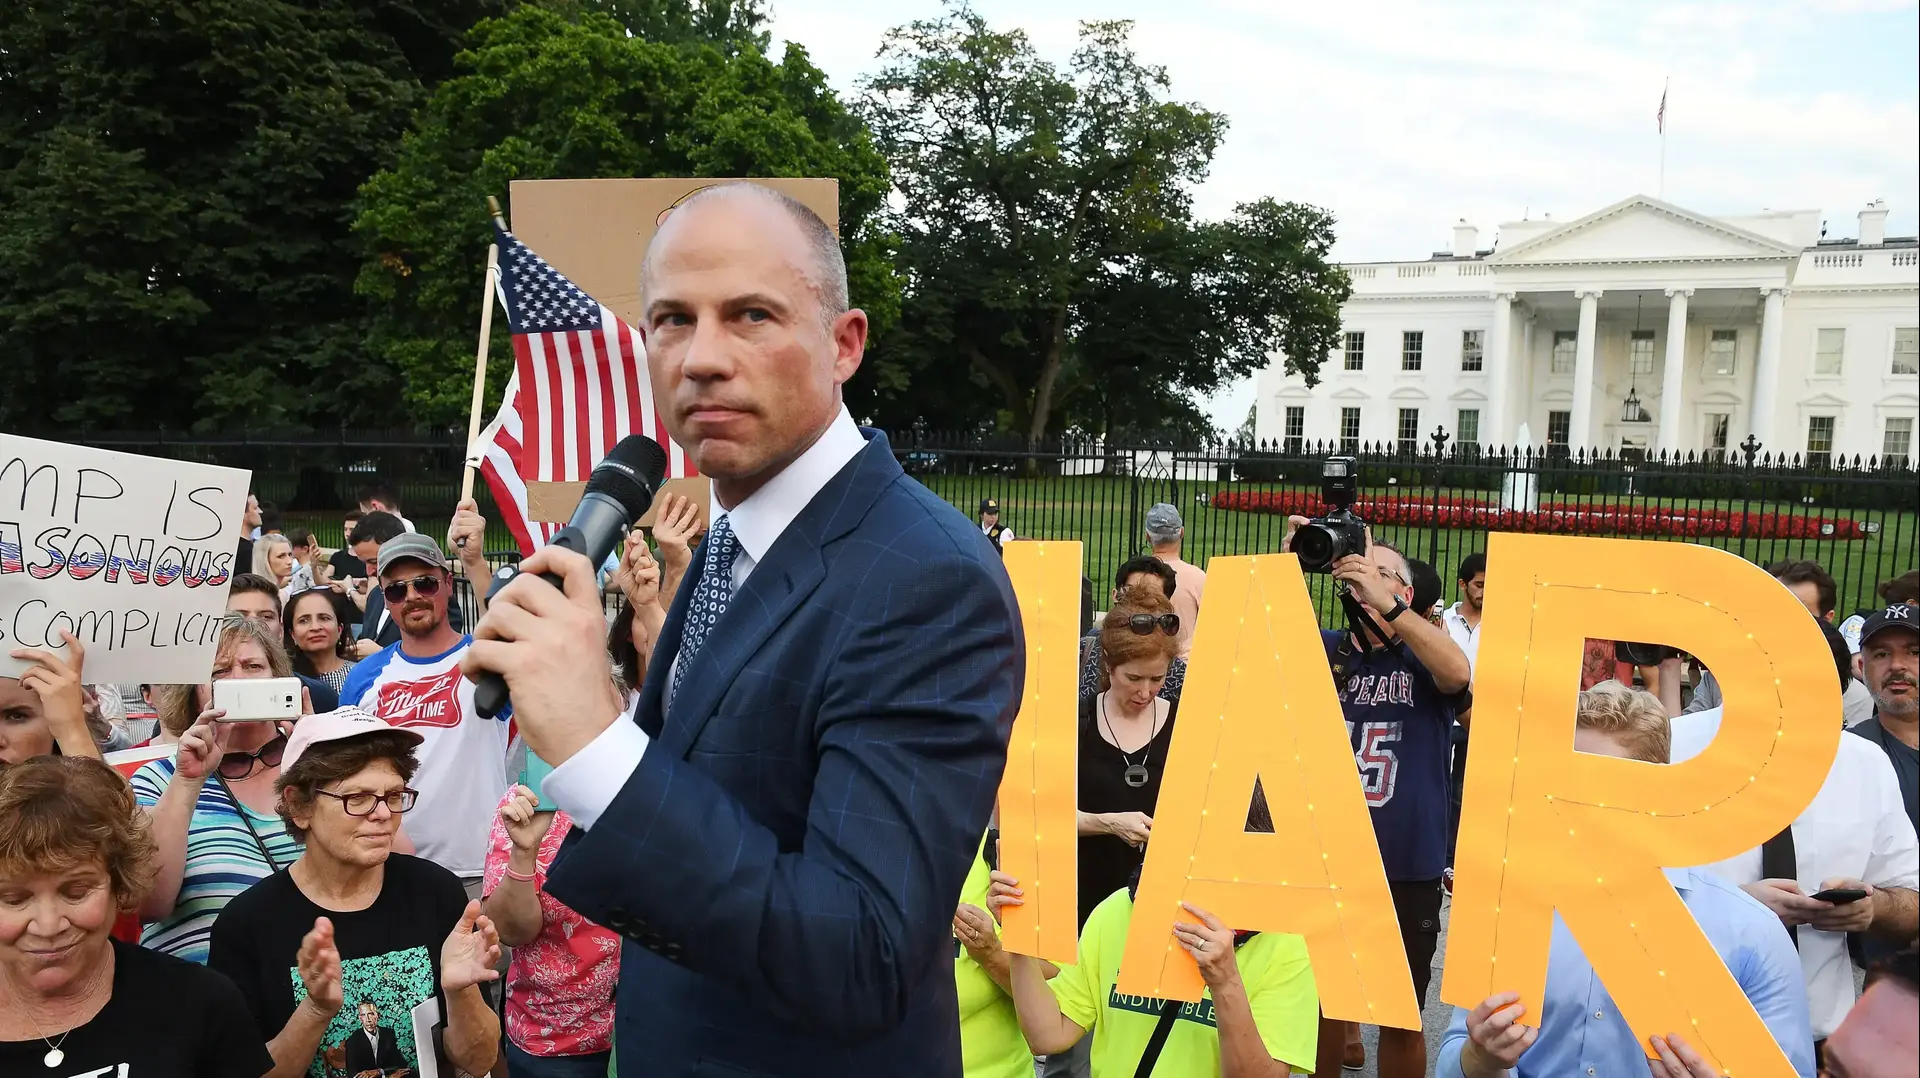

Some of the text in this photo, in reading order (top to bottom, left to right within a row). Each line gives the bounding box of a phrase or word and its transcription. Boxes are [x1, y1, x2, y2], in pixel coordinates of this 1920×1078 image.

[163, 479, 224, 541] IS
[1339, 670, 1415, 707] PEACH
[415, 699, 448, 719] TIME
[1344, 719, 1403, 808] 5
[1110, 992, 1217, 1022] INDIVIBLE
